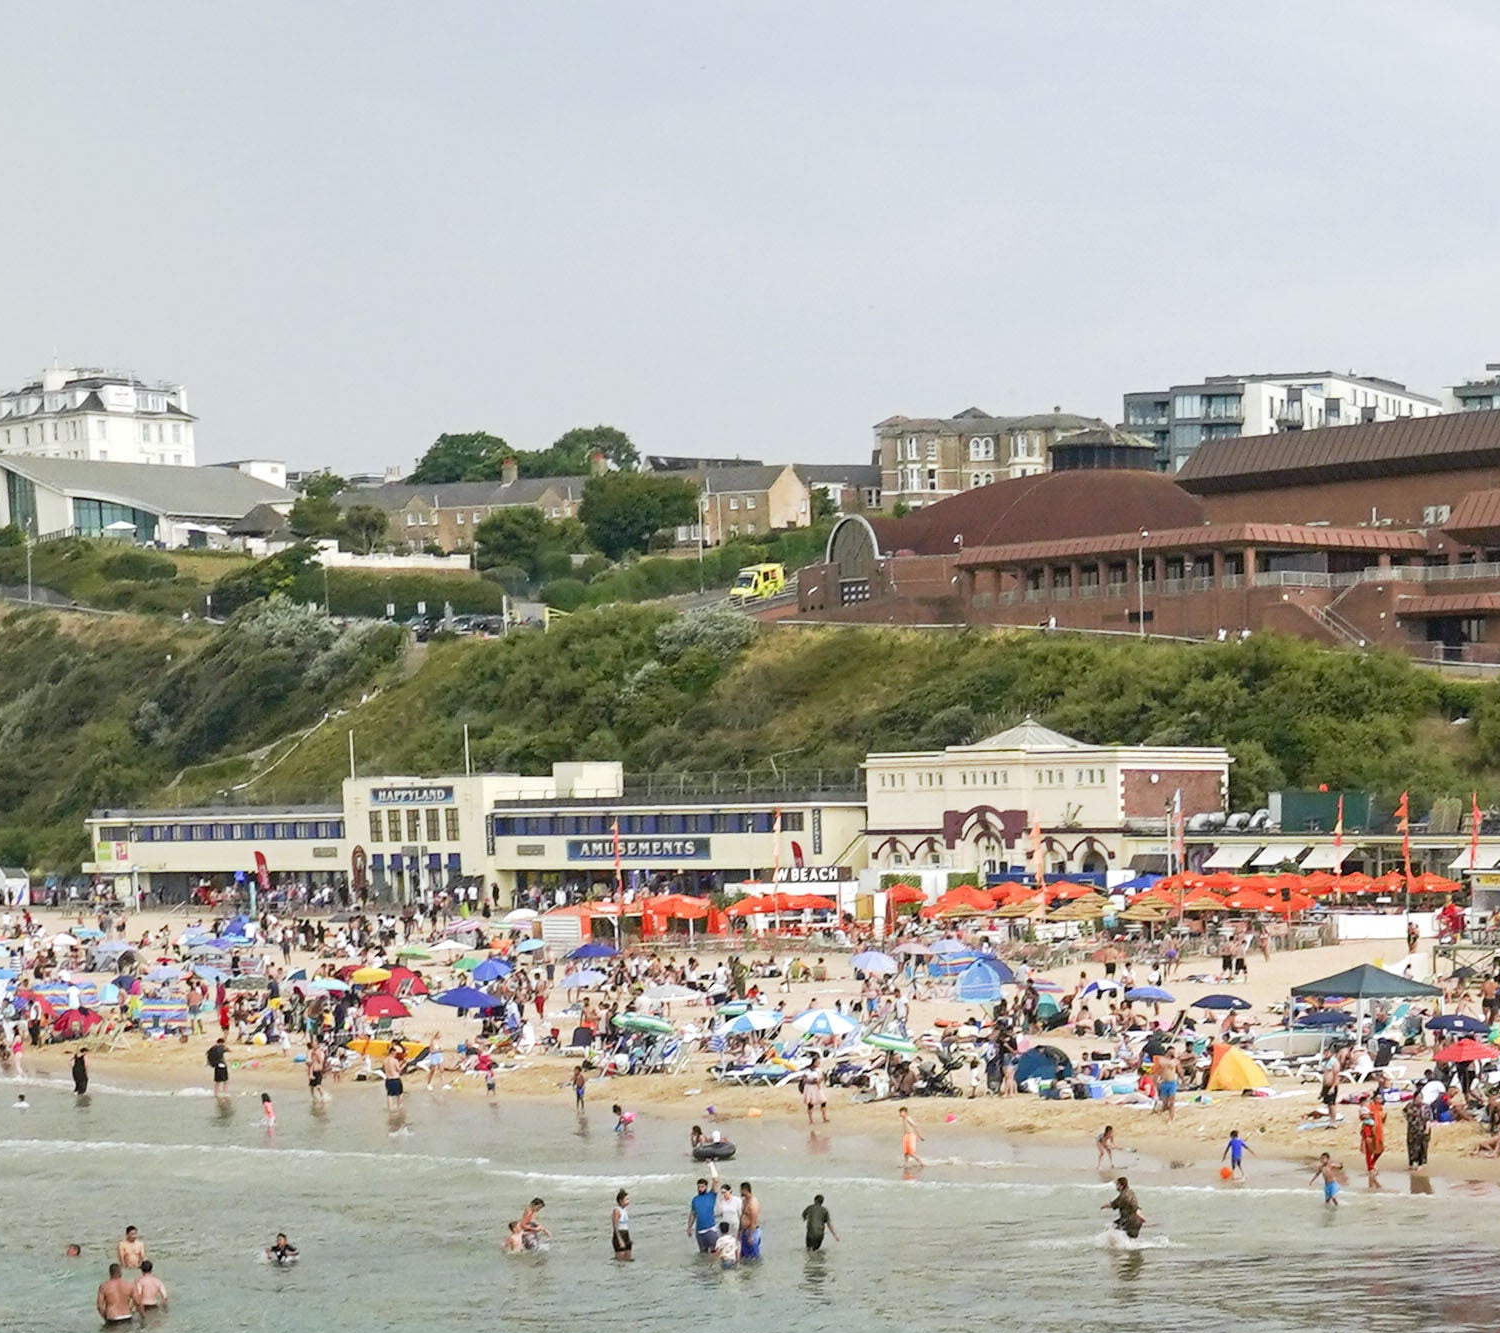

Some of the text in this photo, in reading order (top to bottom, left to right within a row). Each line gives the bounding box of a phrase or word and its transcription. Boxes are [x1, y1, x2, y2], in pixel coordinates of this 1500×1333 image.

[378, 789, 446, 802] HAPPYLAND
[579, 841, 696, 857] AMUSEMENTS
[791, 867, 838, 881] BEACH
